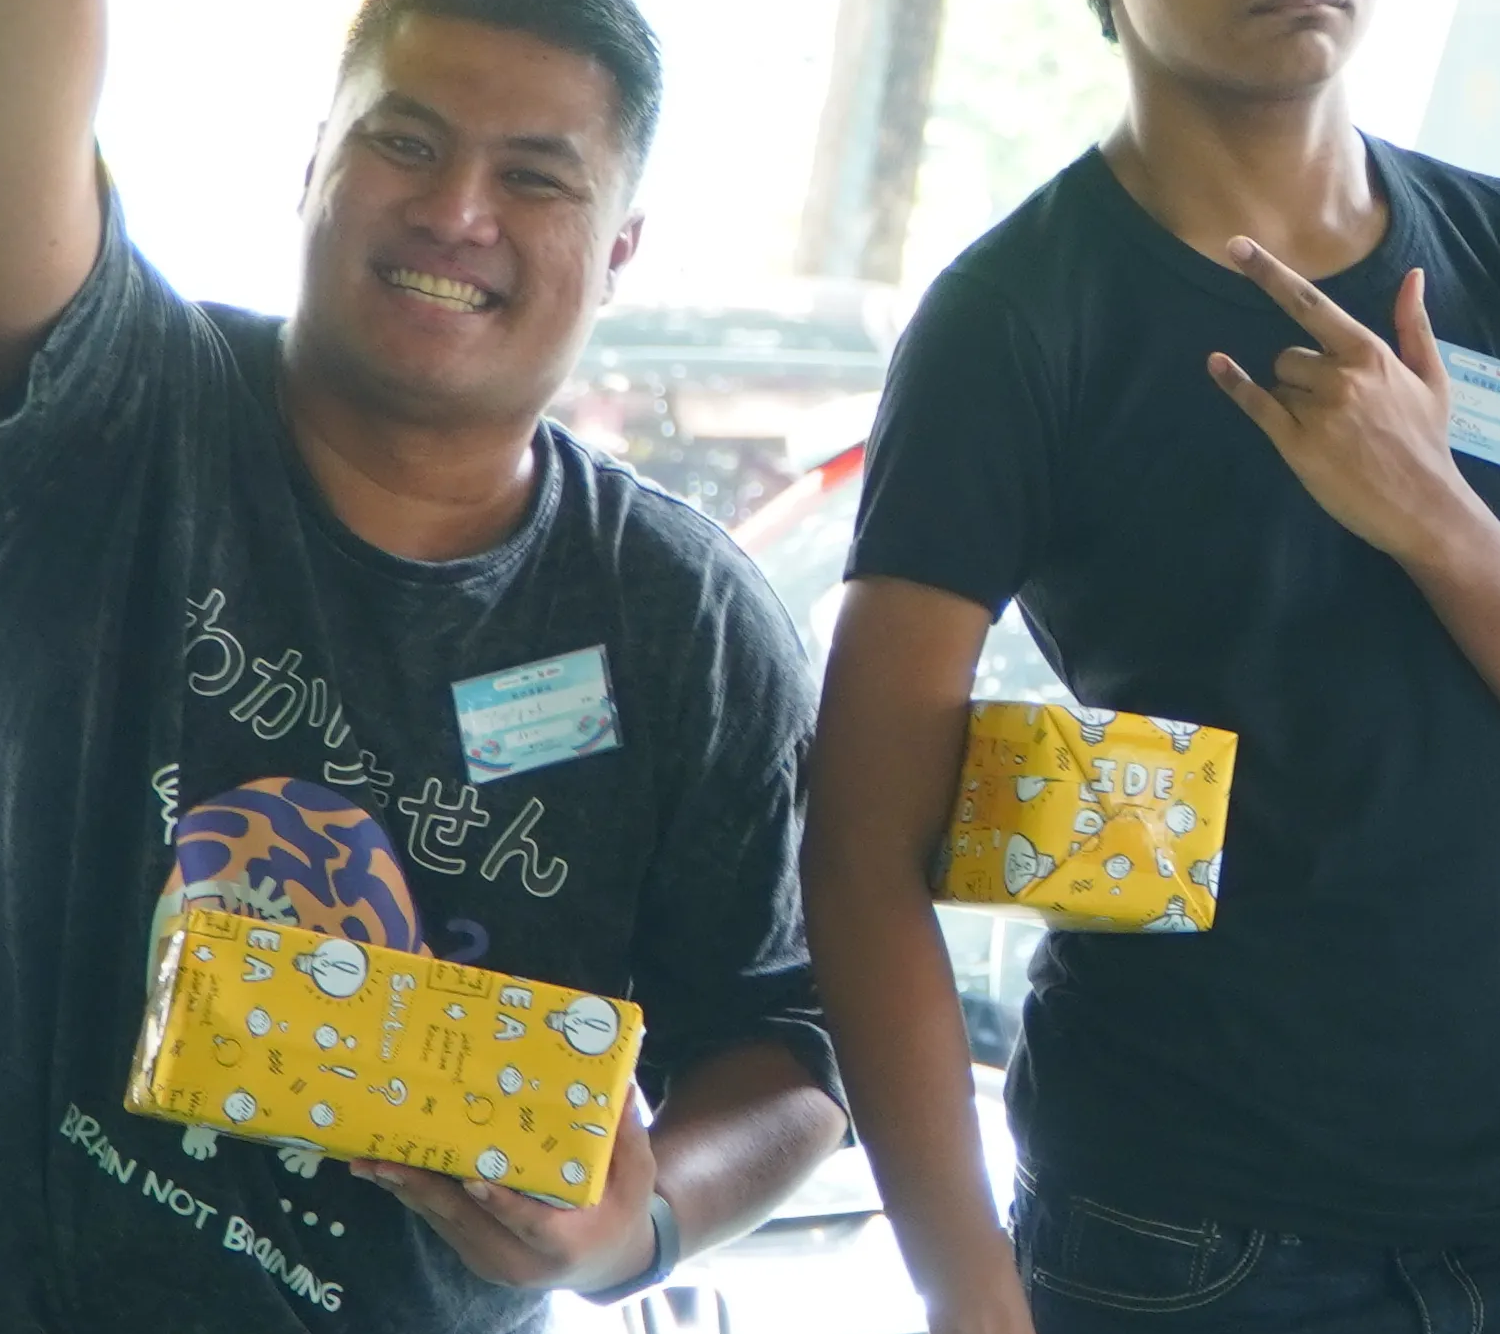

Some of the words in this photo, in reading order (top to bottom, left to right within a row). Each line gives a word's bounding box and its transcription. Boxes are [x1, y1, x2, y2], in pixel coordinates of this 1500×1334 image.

[380, 973, 417, 1061] Solution
[59, 1102, 137, 1185] BRAIN
[142, 1170, 218, 1230] NOT
[222, 1216, 344, 1312] BRAINING
